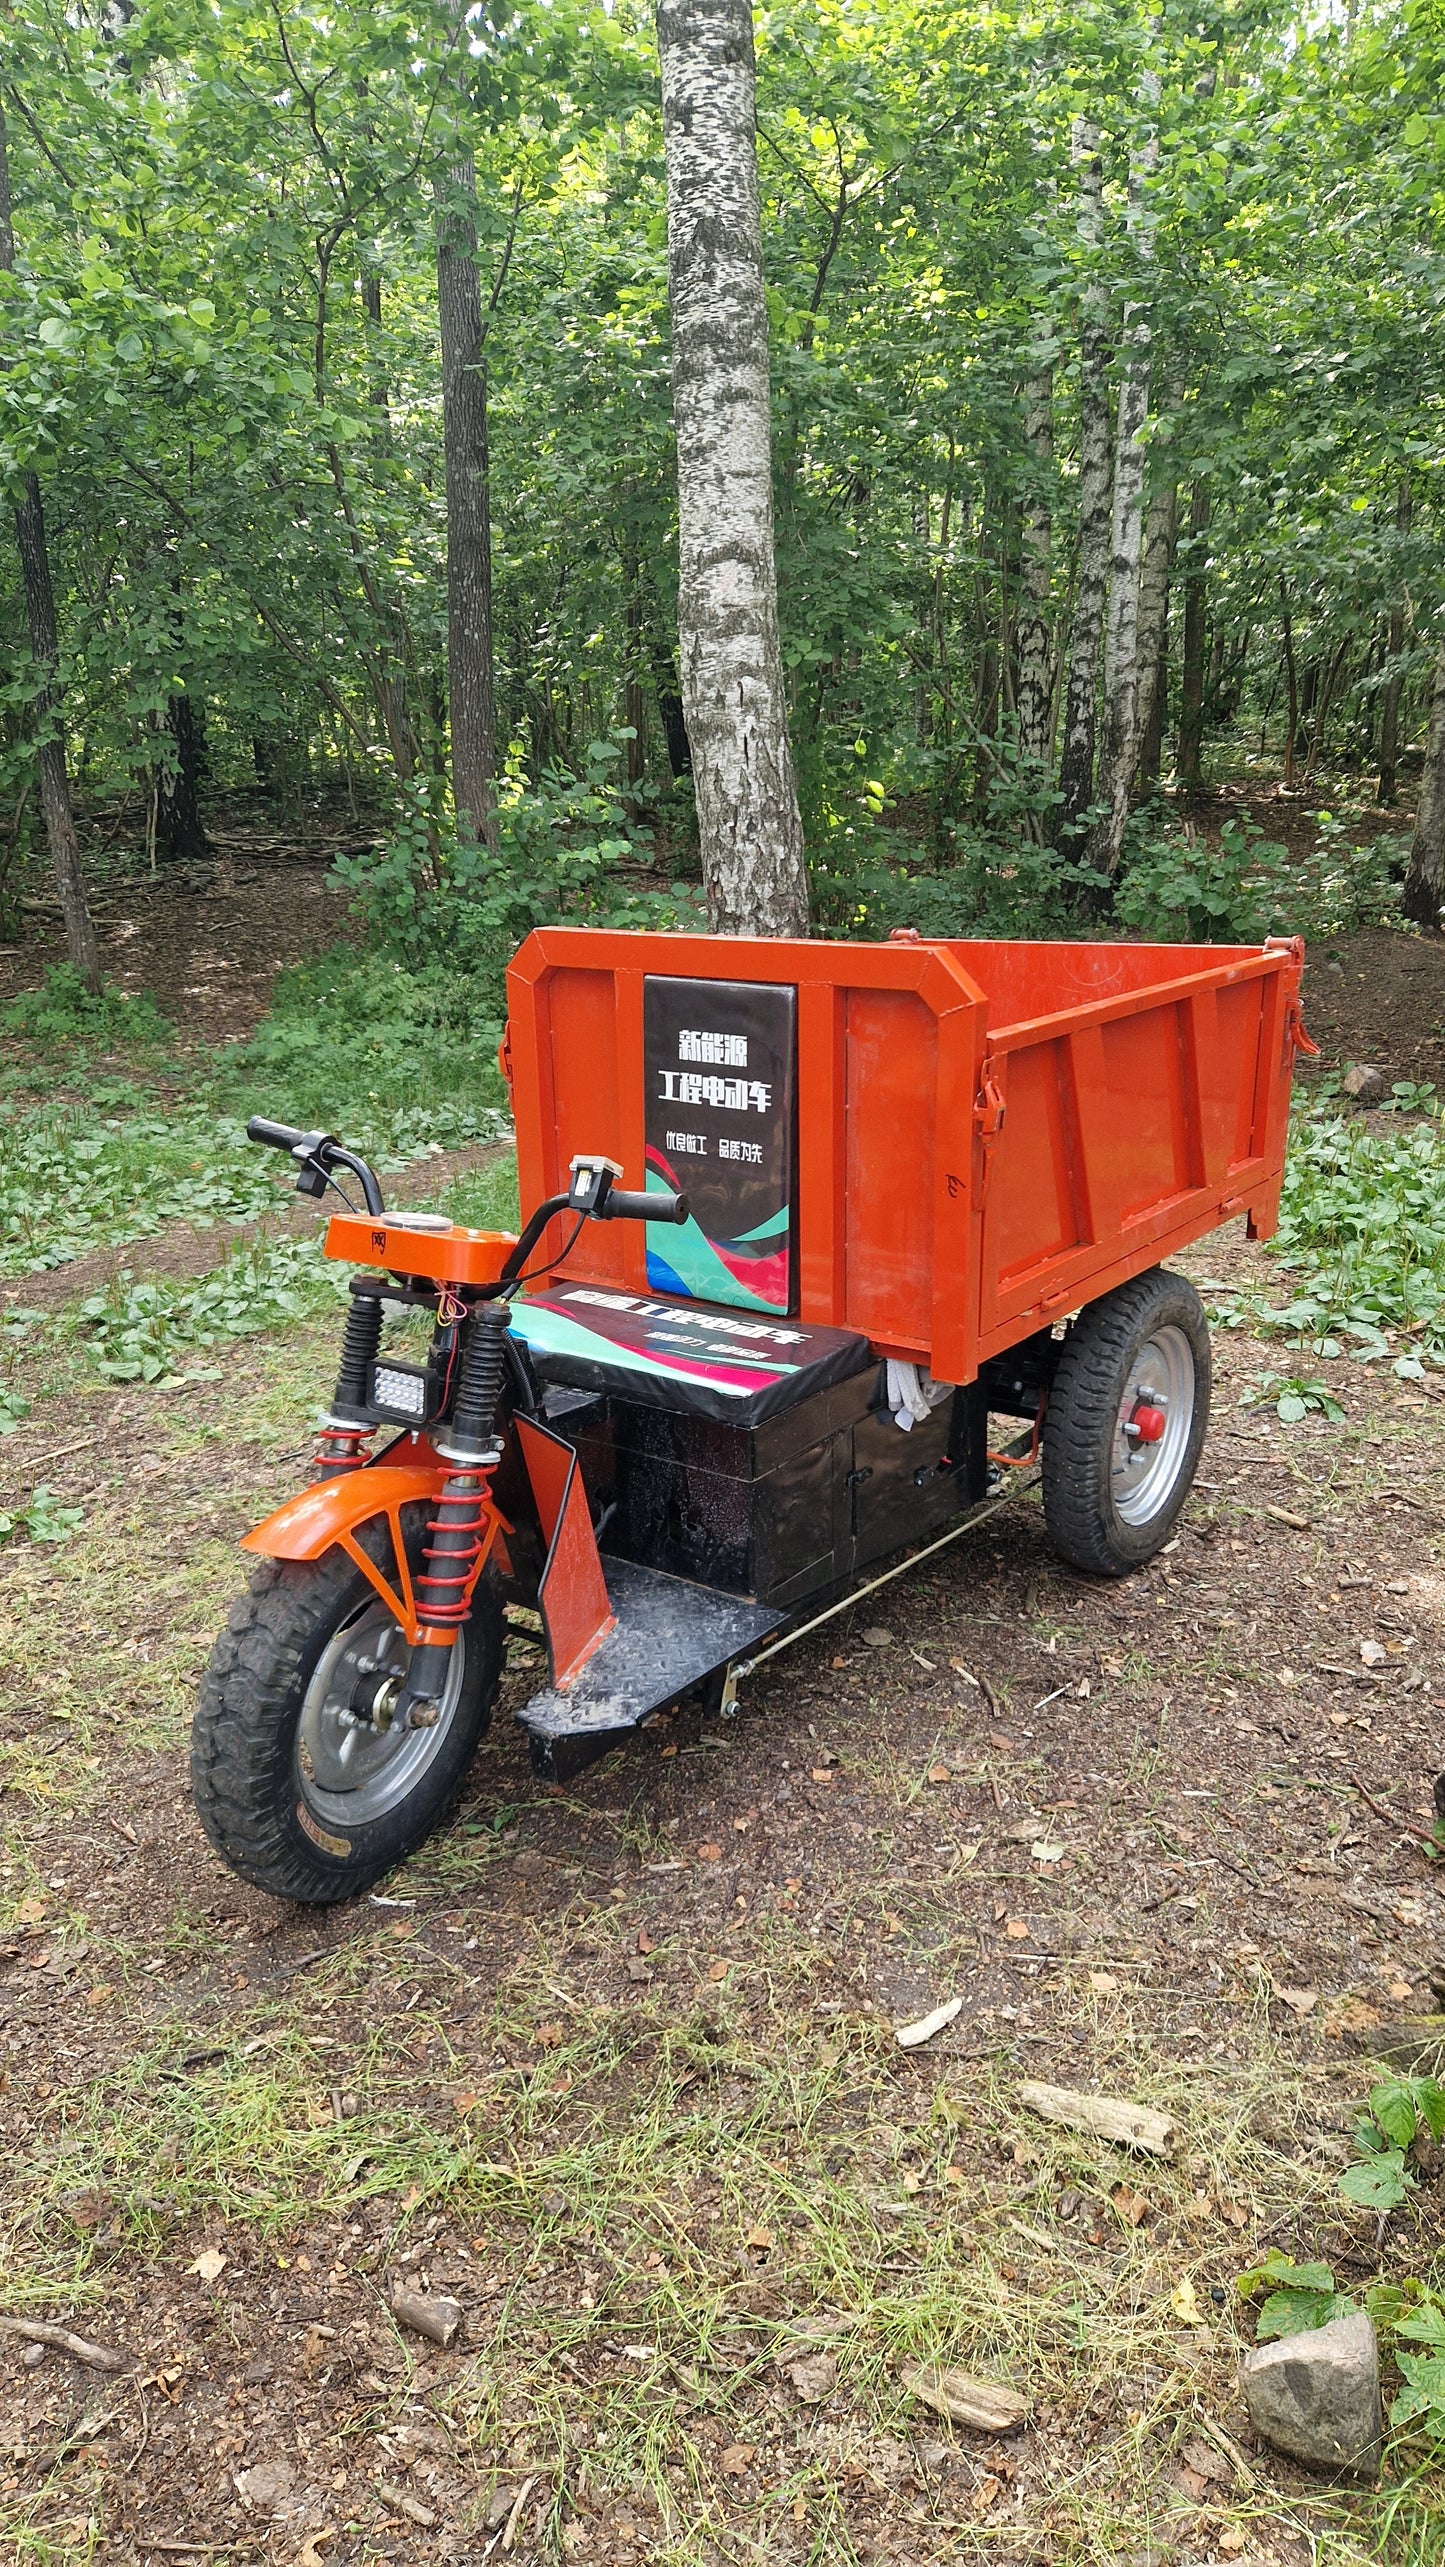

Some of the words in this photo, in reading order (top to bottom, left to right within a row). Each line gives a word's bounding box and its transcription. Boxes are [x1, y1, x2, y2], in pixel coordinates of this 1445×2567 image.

[678, 1029, 748, 1067] 新能源
[658, 1070, 772, 1113] 工程电动车
[666, 1130, 708, 1155] 优良做工
[718, 1138, 763, 1164] 品质为先
